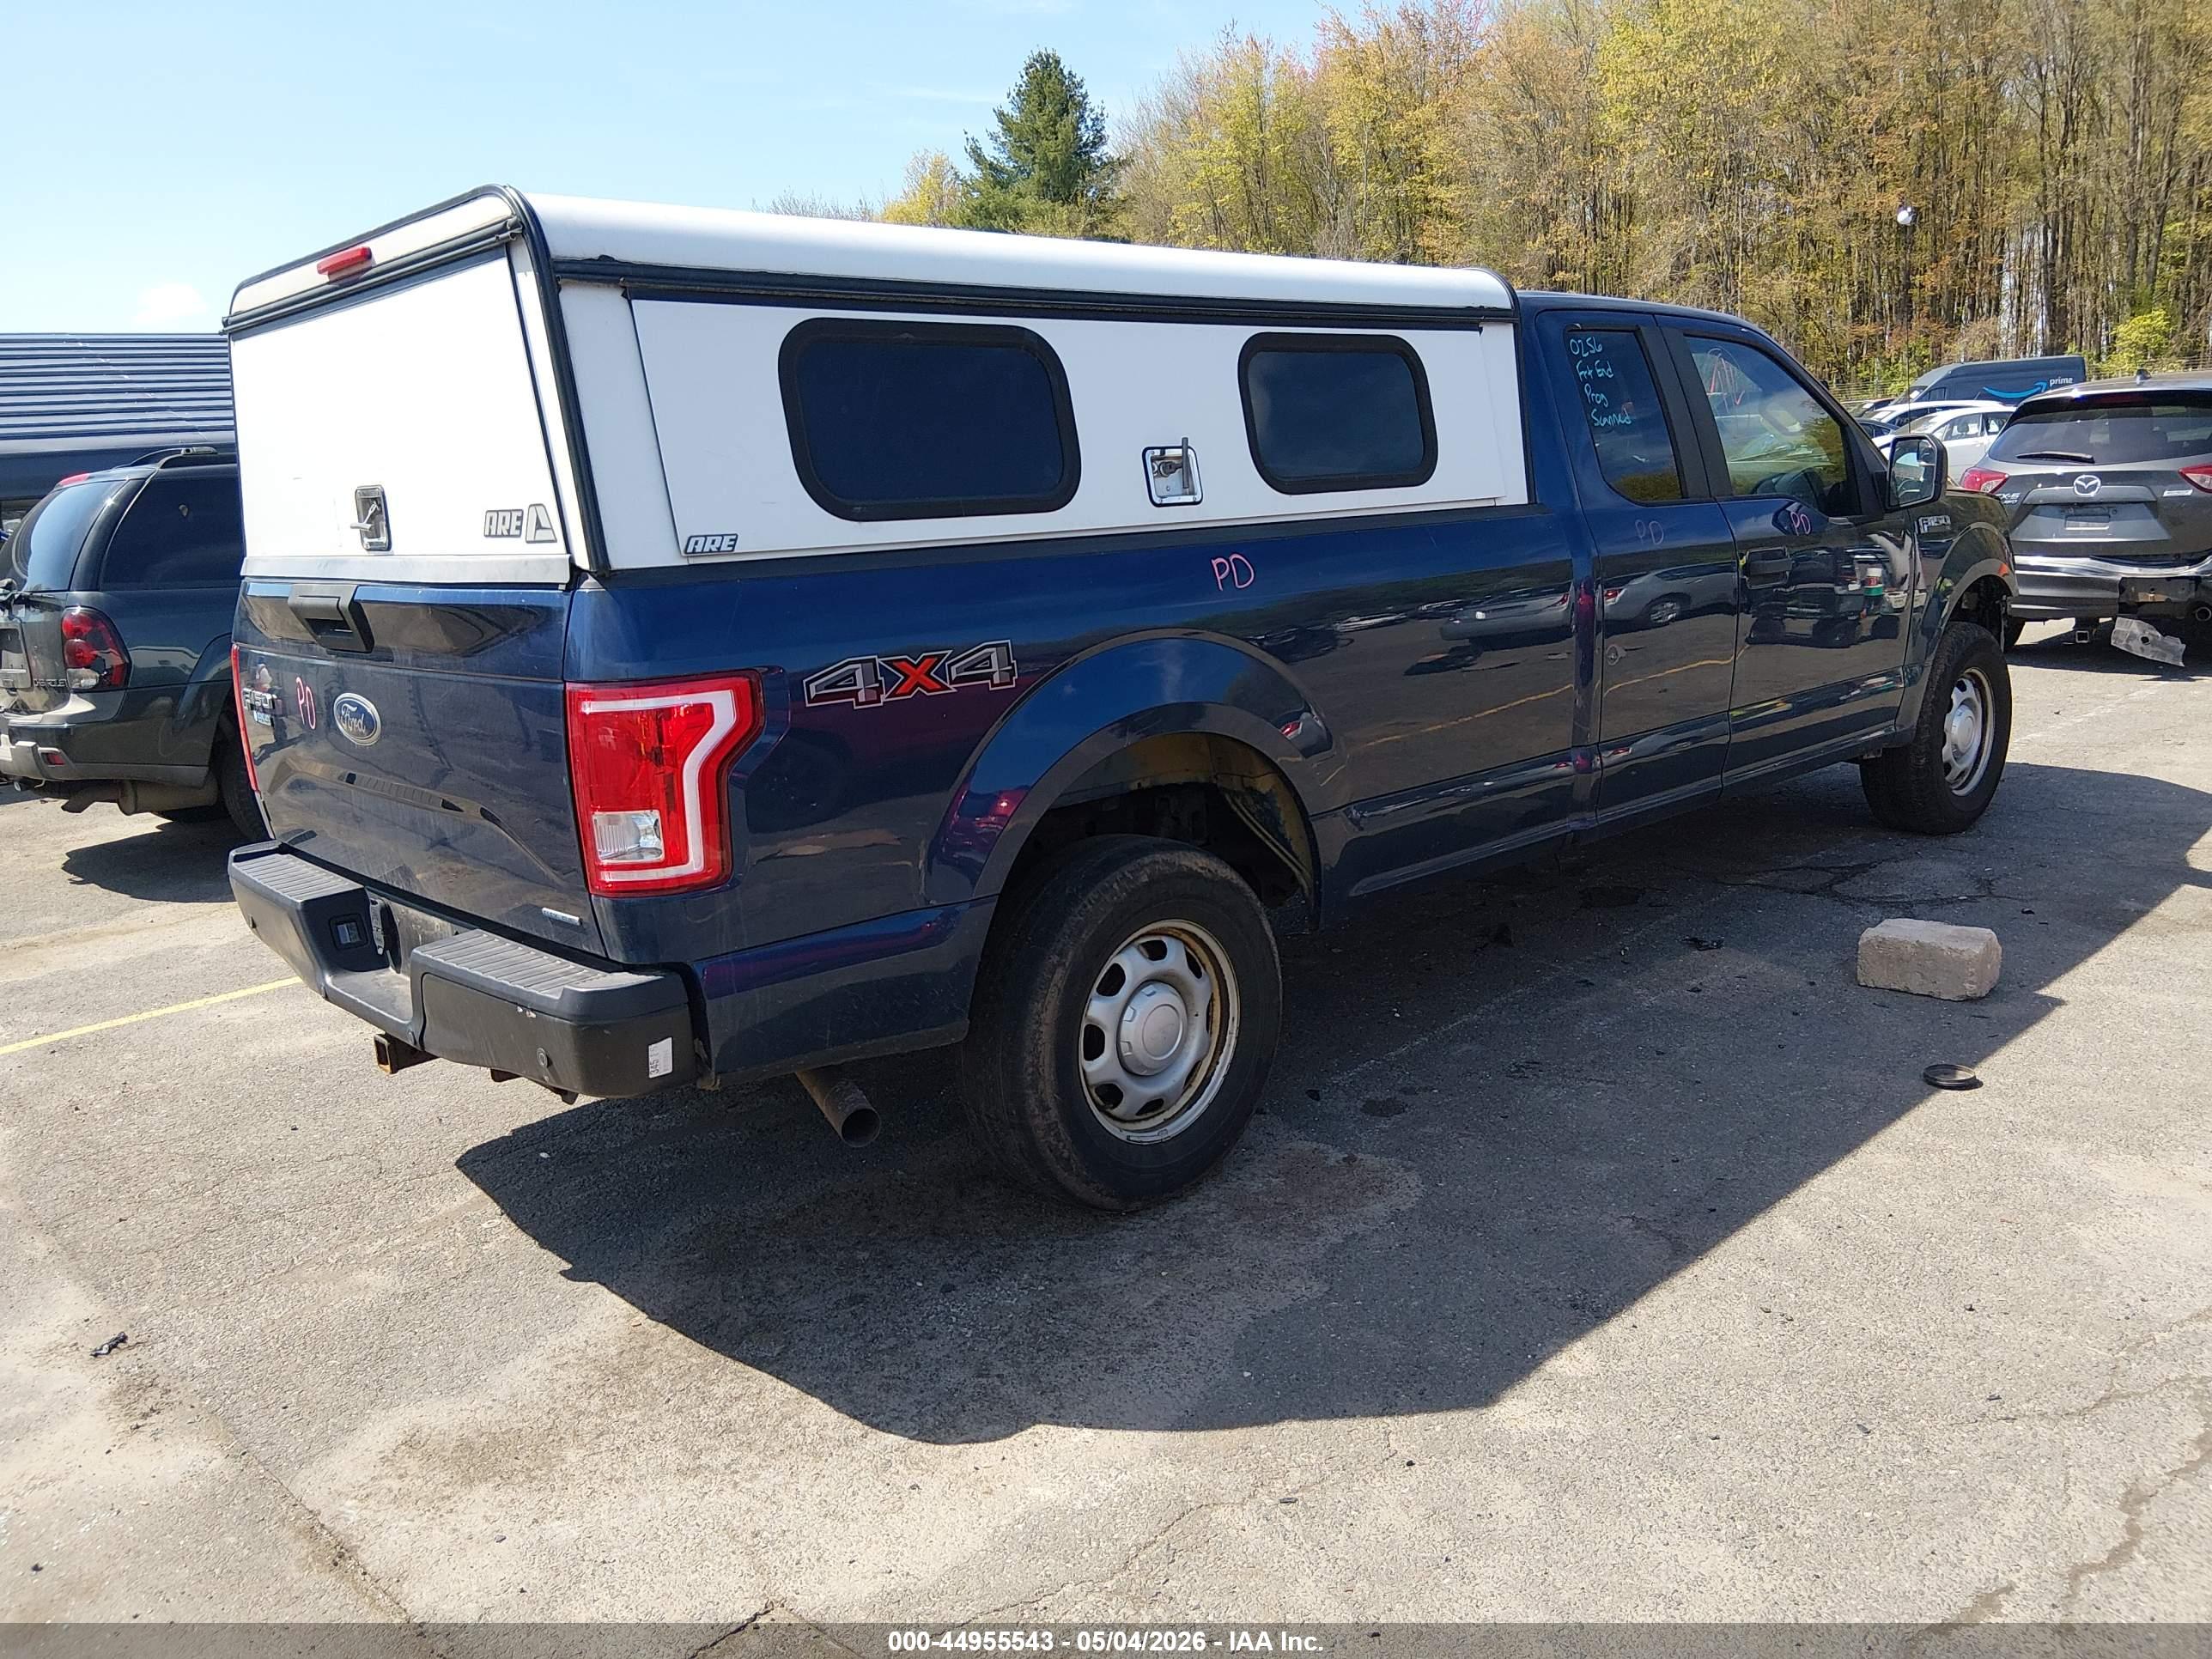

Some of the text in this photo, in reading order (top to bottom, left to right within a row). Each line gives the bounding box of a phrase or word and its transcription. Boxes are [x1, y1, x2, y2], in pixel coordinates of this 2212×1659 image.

[1570, 336, 1602, 357] 0256
[1595, 360, 1614, 378] End
[2049, 376, 2073, 387] prime
[483, 509, 524, 538] ARE
[685, 533, 738, 554] ARE
[1211, 553, 1255, 591] PD
